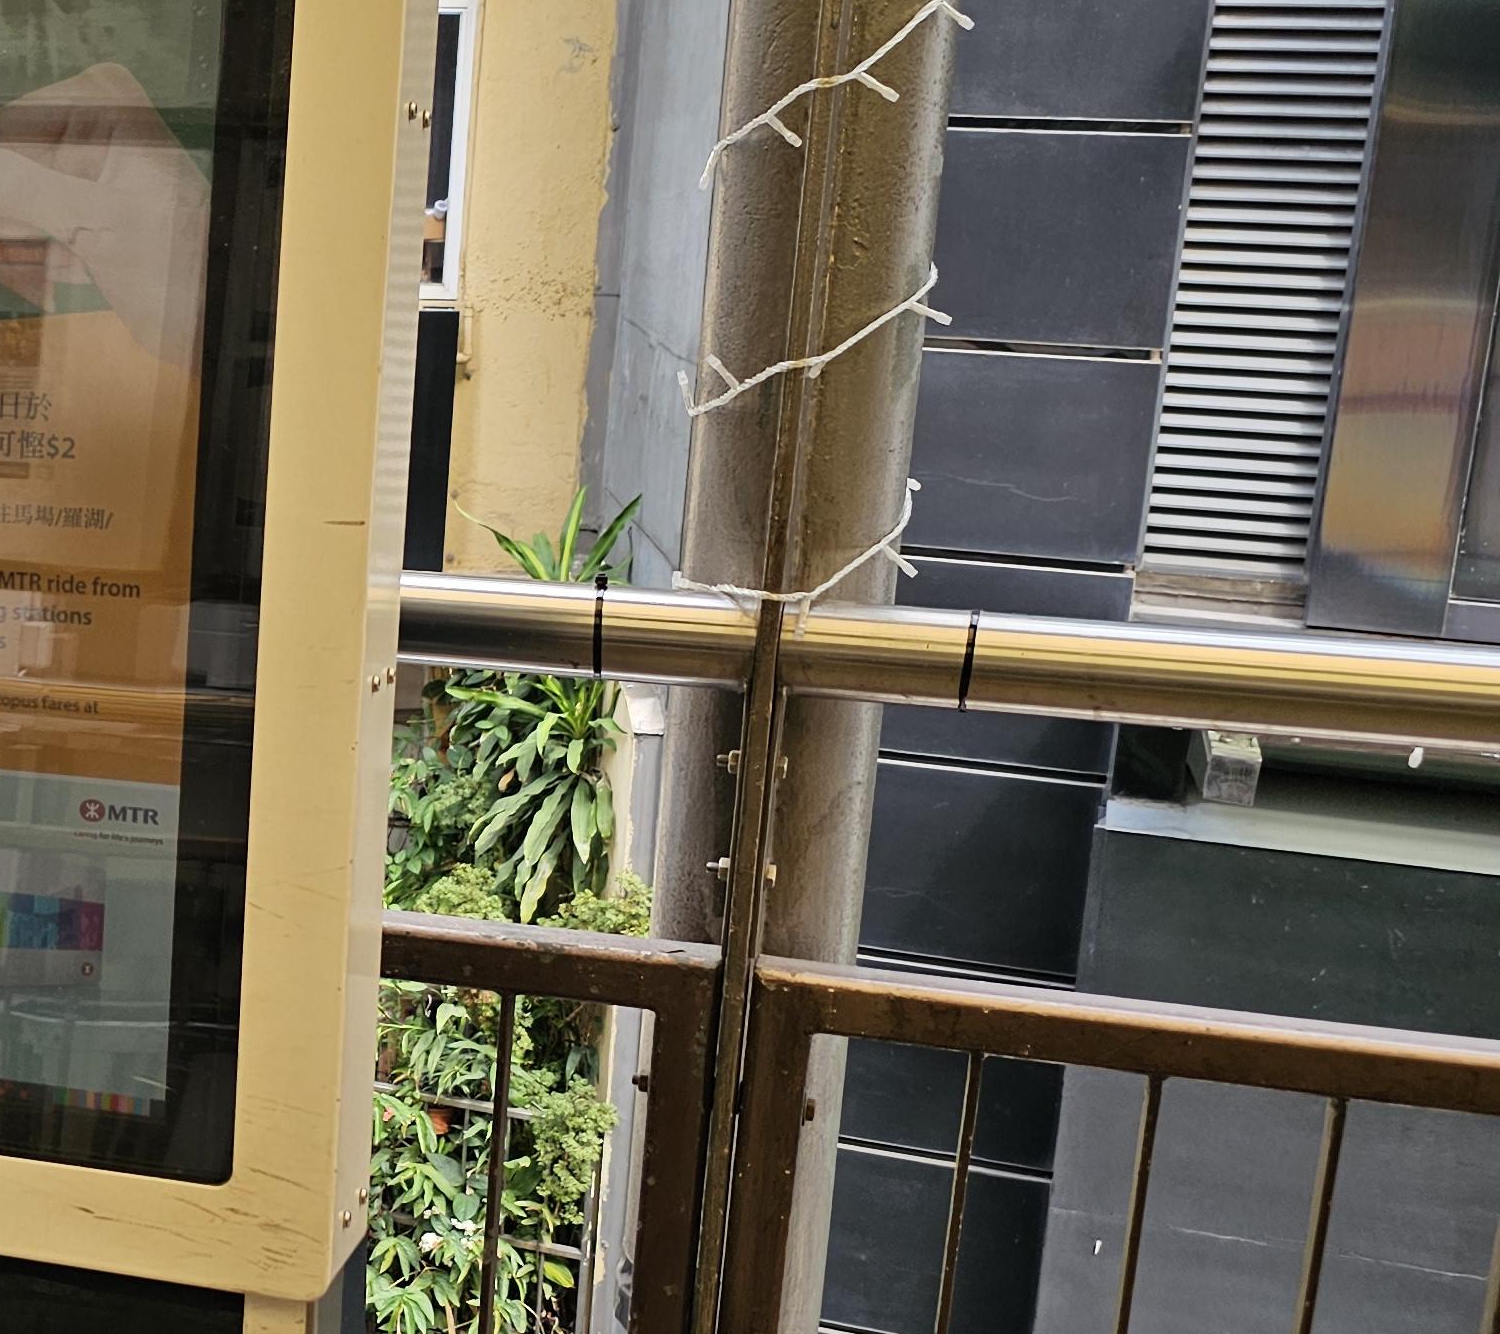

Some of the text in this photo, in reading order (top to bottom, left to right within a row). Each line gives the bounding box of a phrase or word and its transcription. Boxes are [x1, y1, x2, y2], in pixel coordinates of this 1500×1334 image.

[46, 574, 87, 595] ride
[92, 576, 141, 598] from
[41, 696, 80, 713] fares
[83, 700, 99, 715] at
[108, 804, 160, 825] MTR
